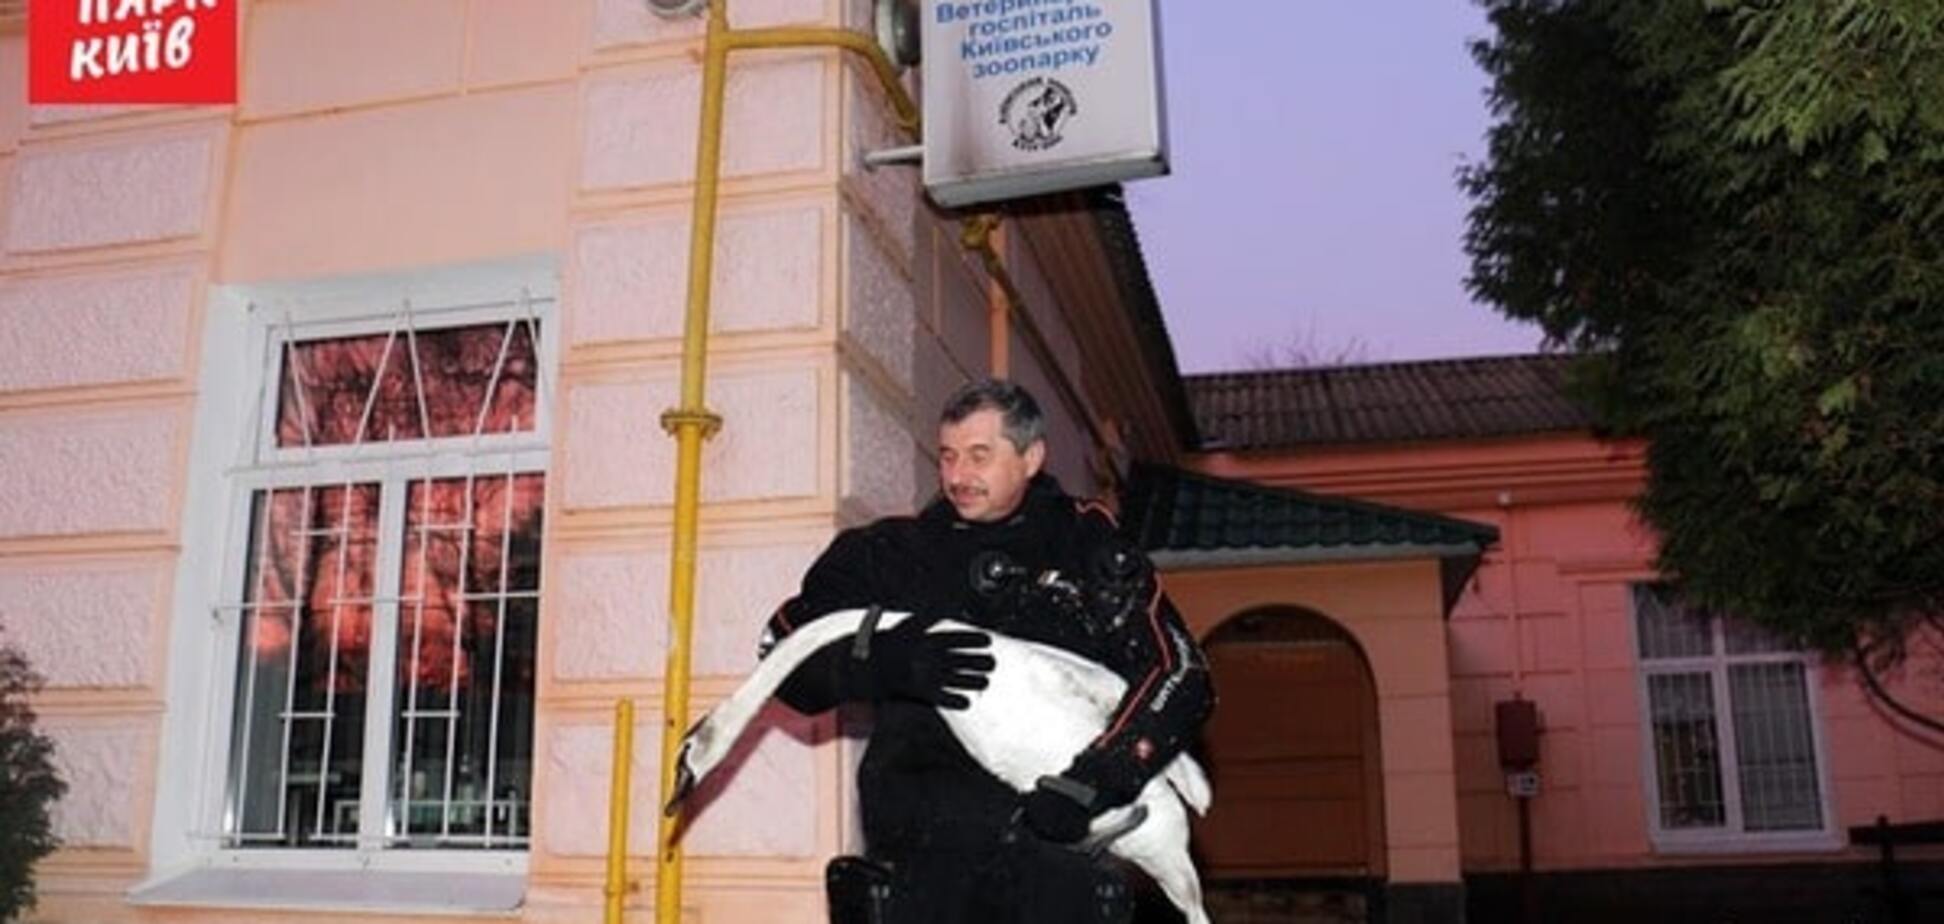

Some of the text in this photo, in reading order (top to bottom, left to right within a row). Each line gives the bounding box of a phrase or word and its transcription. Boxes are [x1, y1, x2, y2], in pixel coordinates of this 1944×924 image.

[969, 5, 1101, 36] госпіталь
[961, 22, 1112, 59] Київського
[973, 46, 1098, 78] зоопарку
